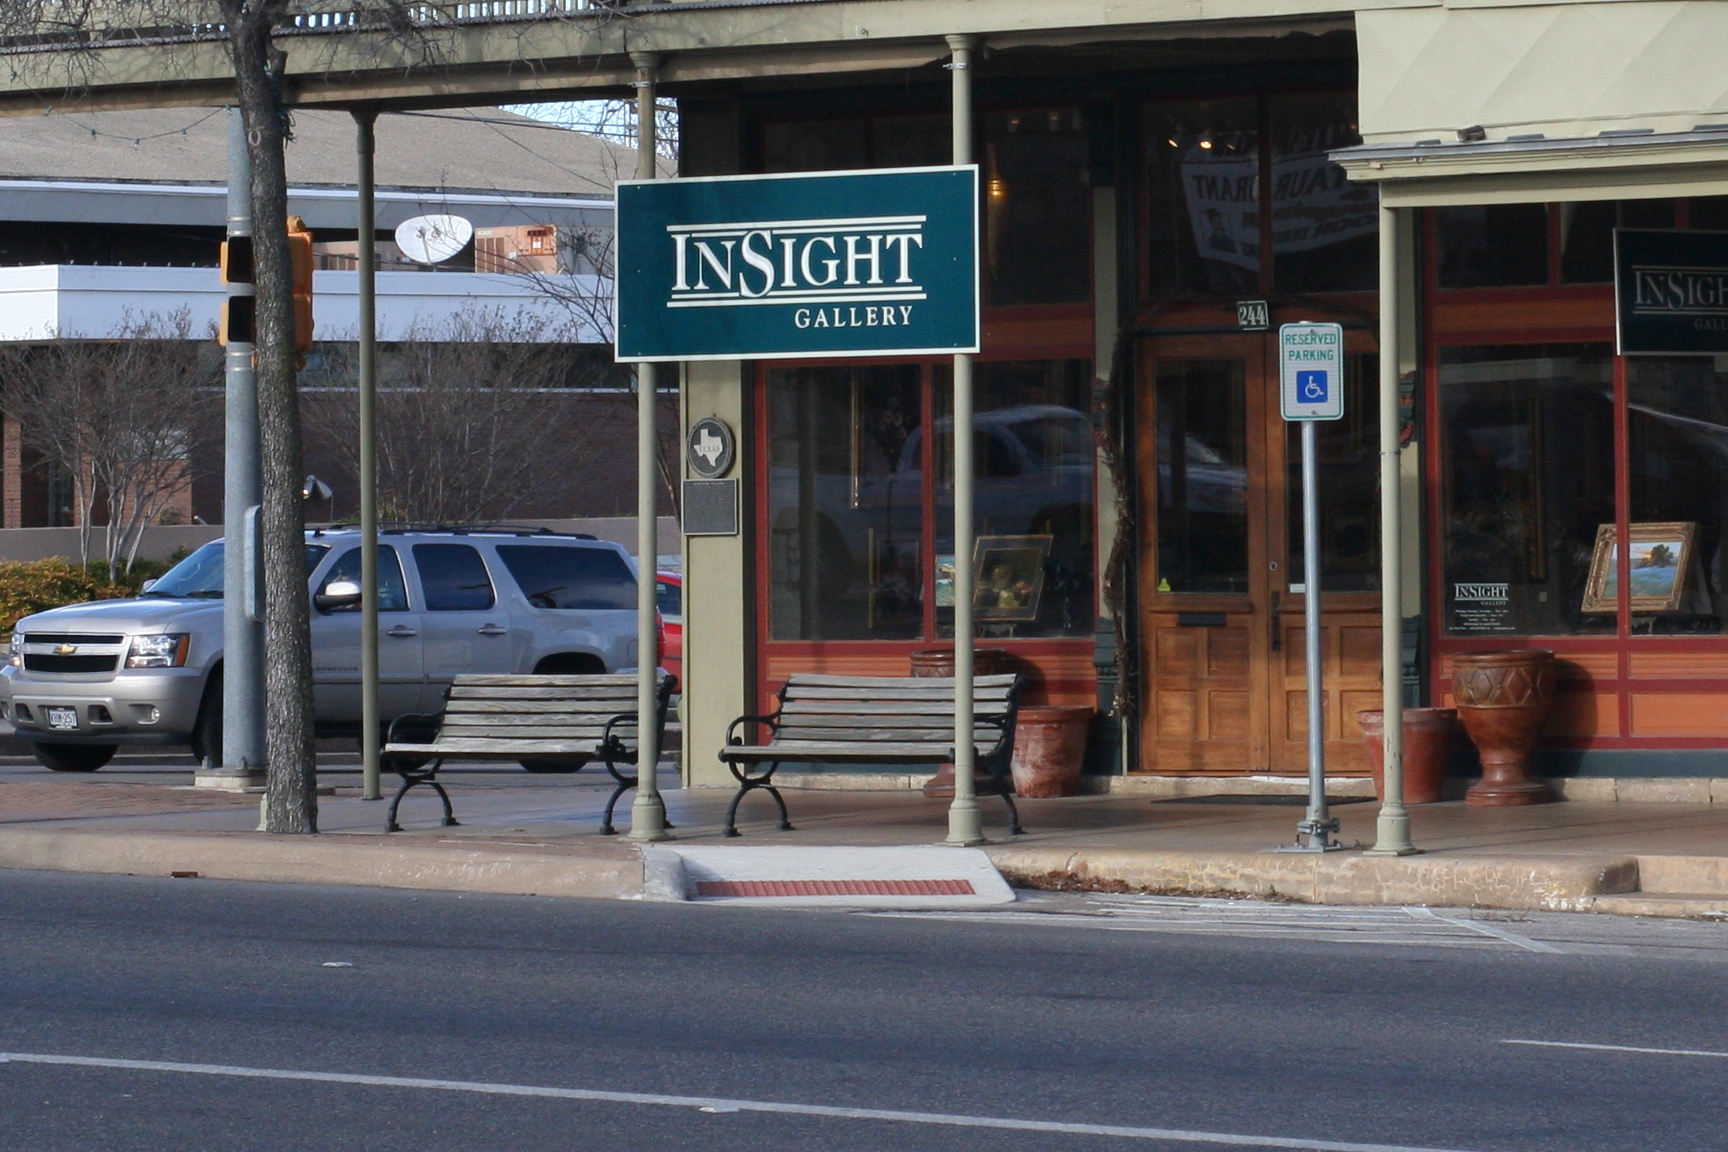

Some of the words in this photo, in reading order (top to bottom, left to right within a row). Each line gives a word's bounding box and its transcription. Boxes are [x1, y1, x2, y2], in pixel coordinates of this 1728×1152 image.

[670, 229, 924, 298] INSIGHT
[794, 304, 914, 329] GALLERY
[1239, 305, 1267, 326] 244
[1284, 333, 1337, 345] RESERVED
[1288, 349, 1335, 361] PARKING
[699, 445, 721, 453] TEXAS
[1455, 585, 1509, 599] INSIGHT
